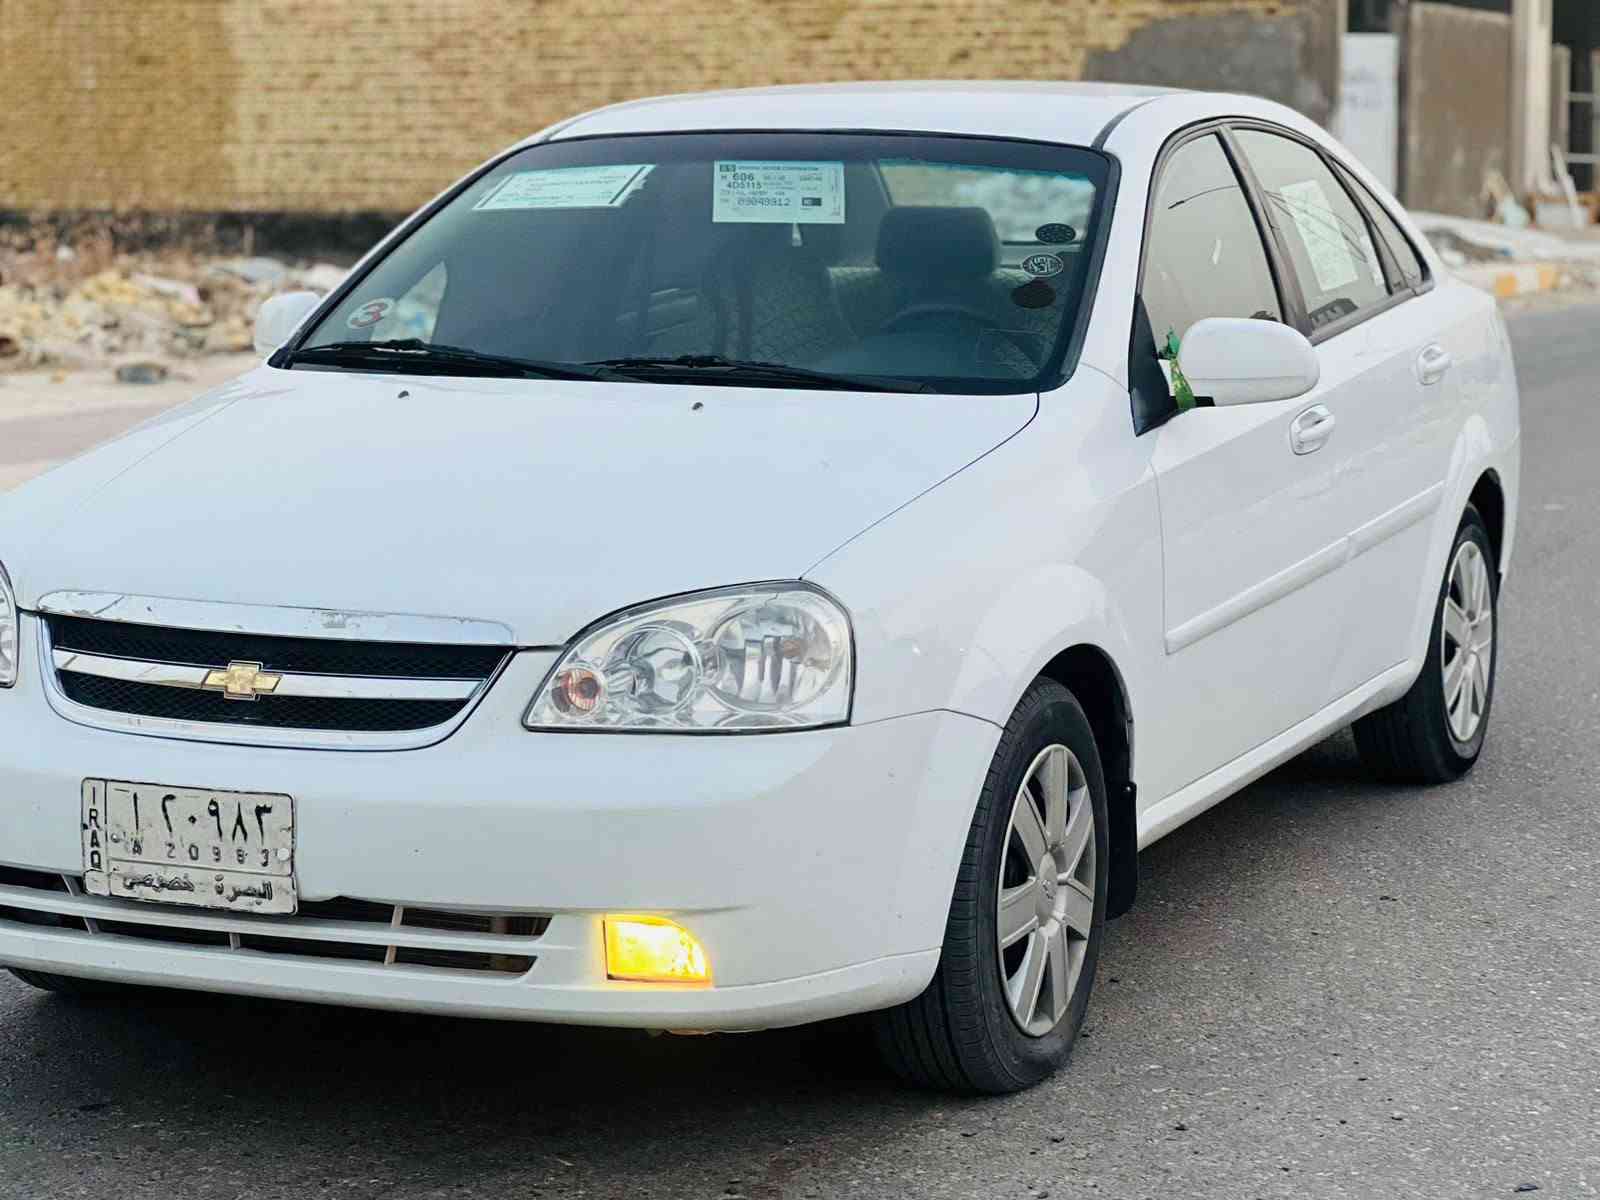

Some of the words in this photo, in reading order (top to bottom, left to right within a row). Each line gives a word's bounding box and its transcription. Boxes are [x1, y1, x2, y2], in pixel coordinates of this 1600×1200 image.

[88, 786, 102, 870] IRAQ
[122, 871, 195, 892] خصوصي
[214, 873, 273, 906] البصرة
